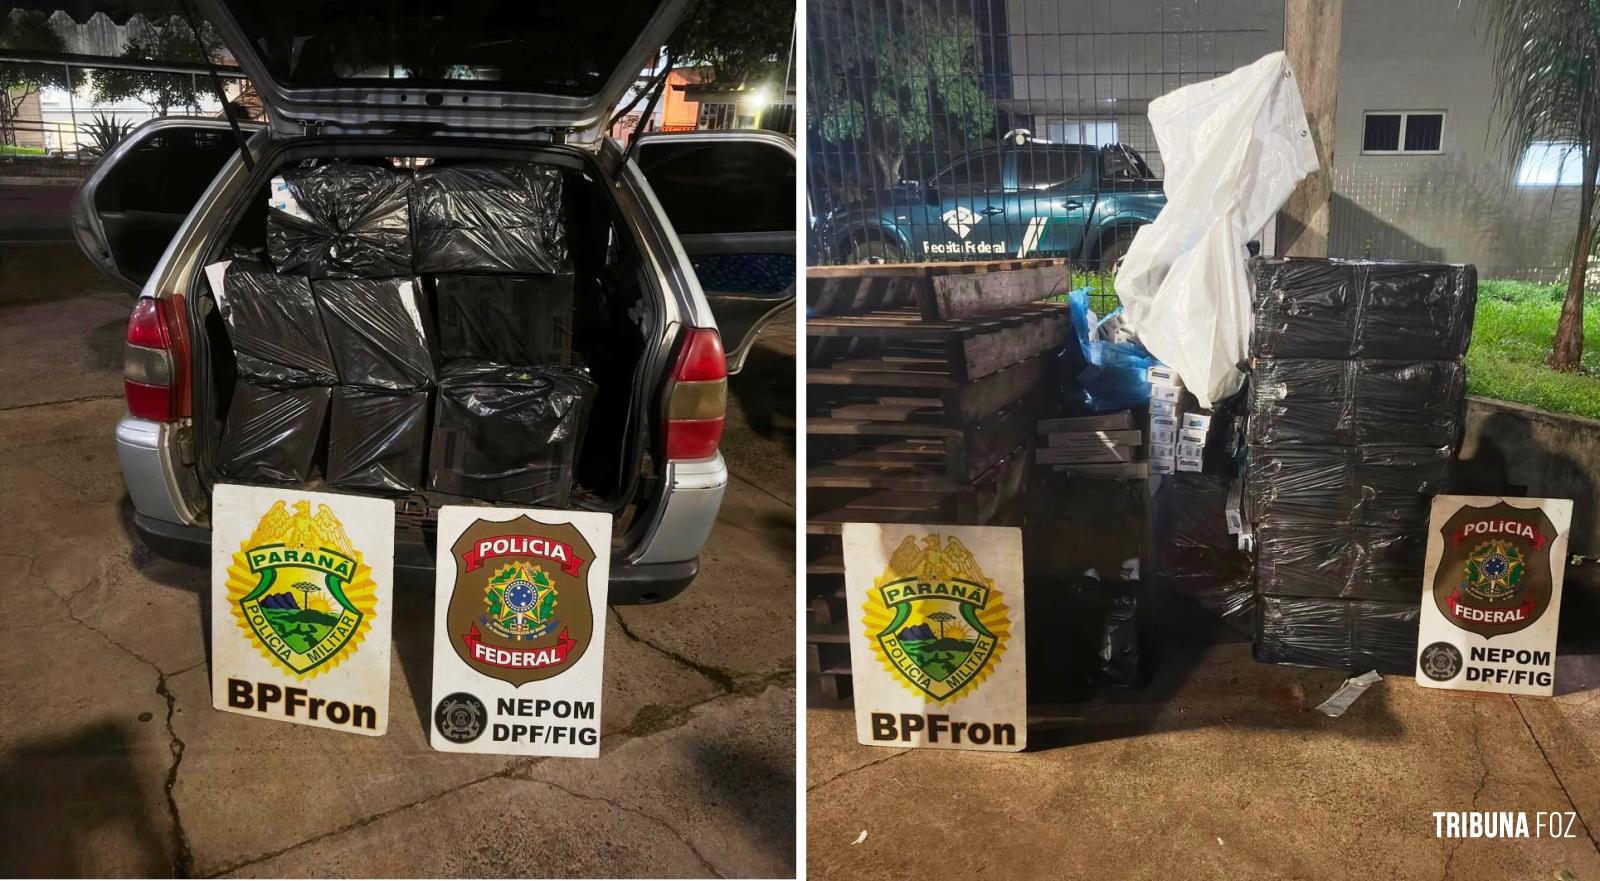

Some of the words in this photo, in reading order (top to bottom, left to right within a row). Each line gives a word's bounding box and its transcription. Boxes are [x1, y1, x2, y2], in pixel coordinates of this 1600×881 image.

[965, 241, 1006, 254] Federal
[252, 549, 352, 576] PARANÁ
[886, 582, 982, 603] PARANÁ
[1455, 603, 1525, 623] FEDERAL
[246, 604, 292, 662] POLÍCIA
[306, 616, 356, 664] MILITAR
[475, 644, 561, 667] FEDERAL
[884, 638, 932, 690] POLÍCIA
[946, 639, 991, 690] MILITAR
[1470, 646, 1551, 666] NEPOM
[1466, 667, 1552, 687] DPF/FIG
[227, 678, 377, 730] BPFron
[496, 698, 595, 720] NEPOM
[492, 723, 598, 746] DPF/FIG
[871, 712, 1017, 746] BPFron
